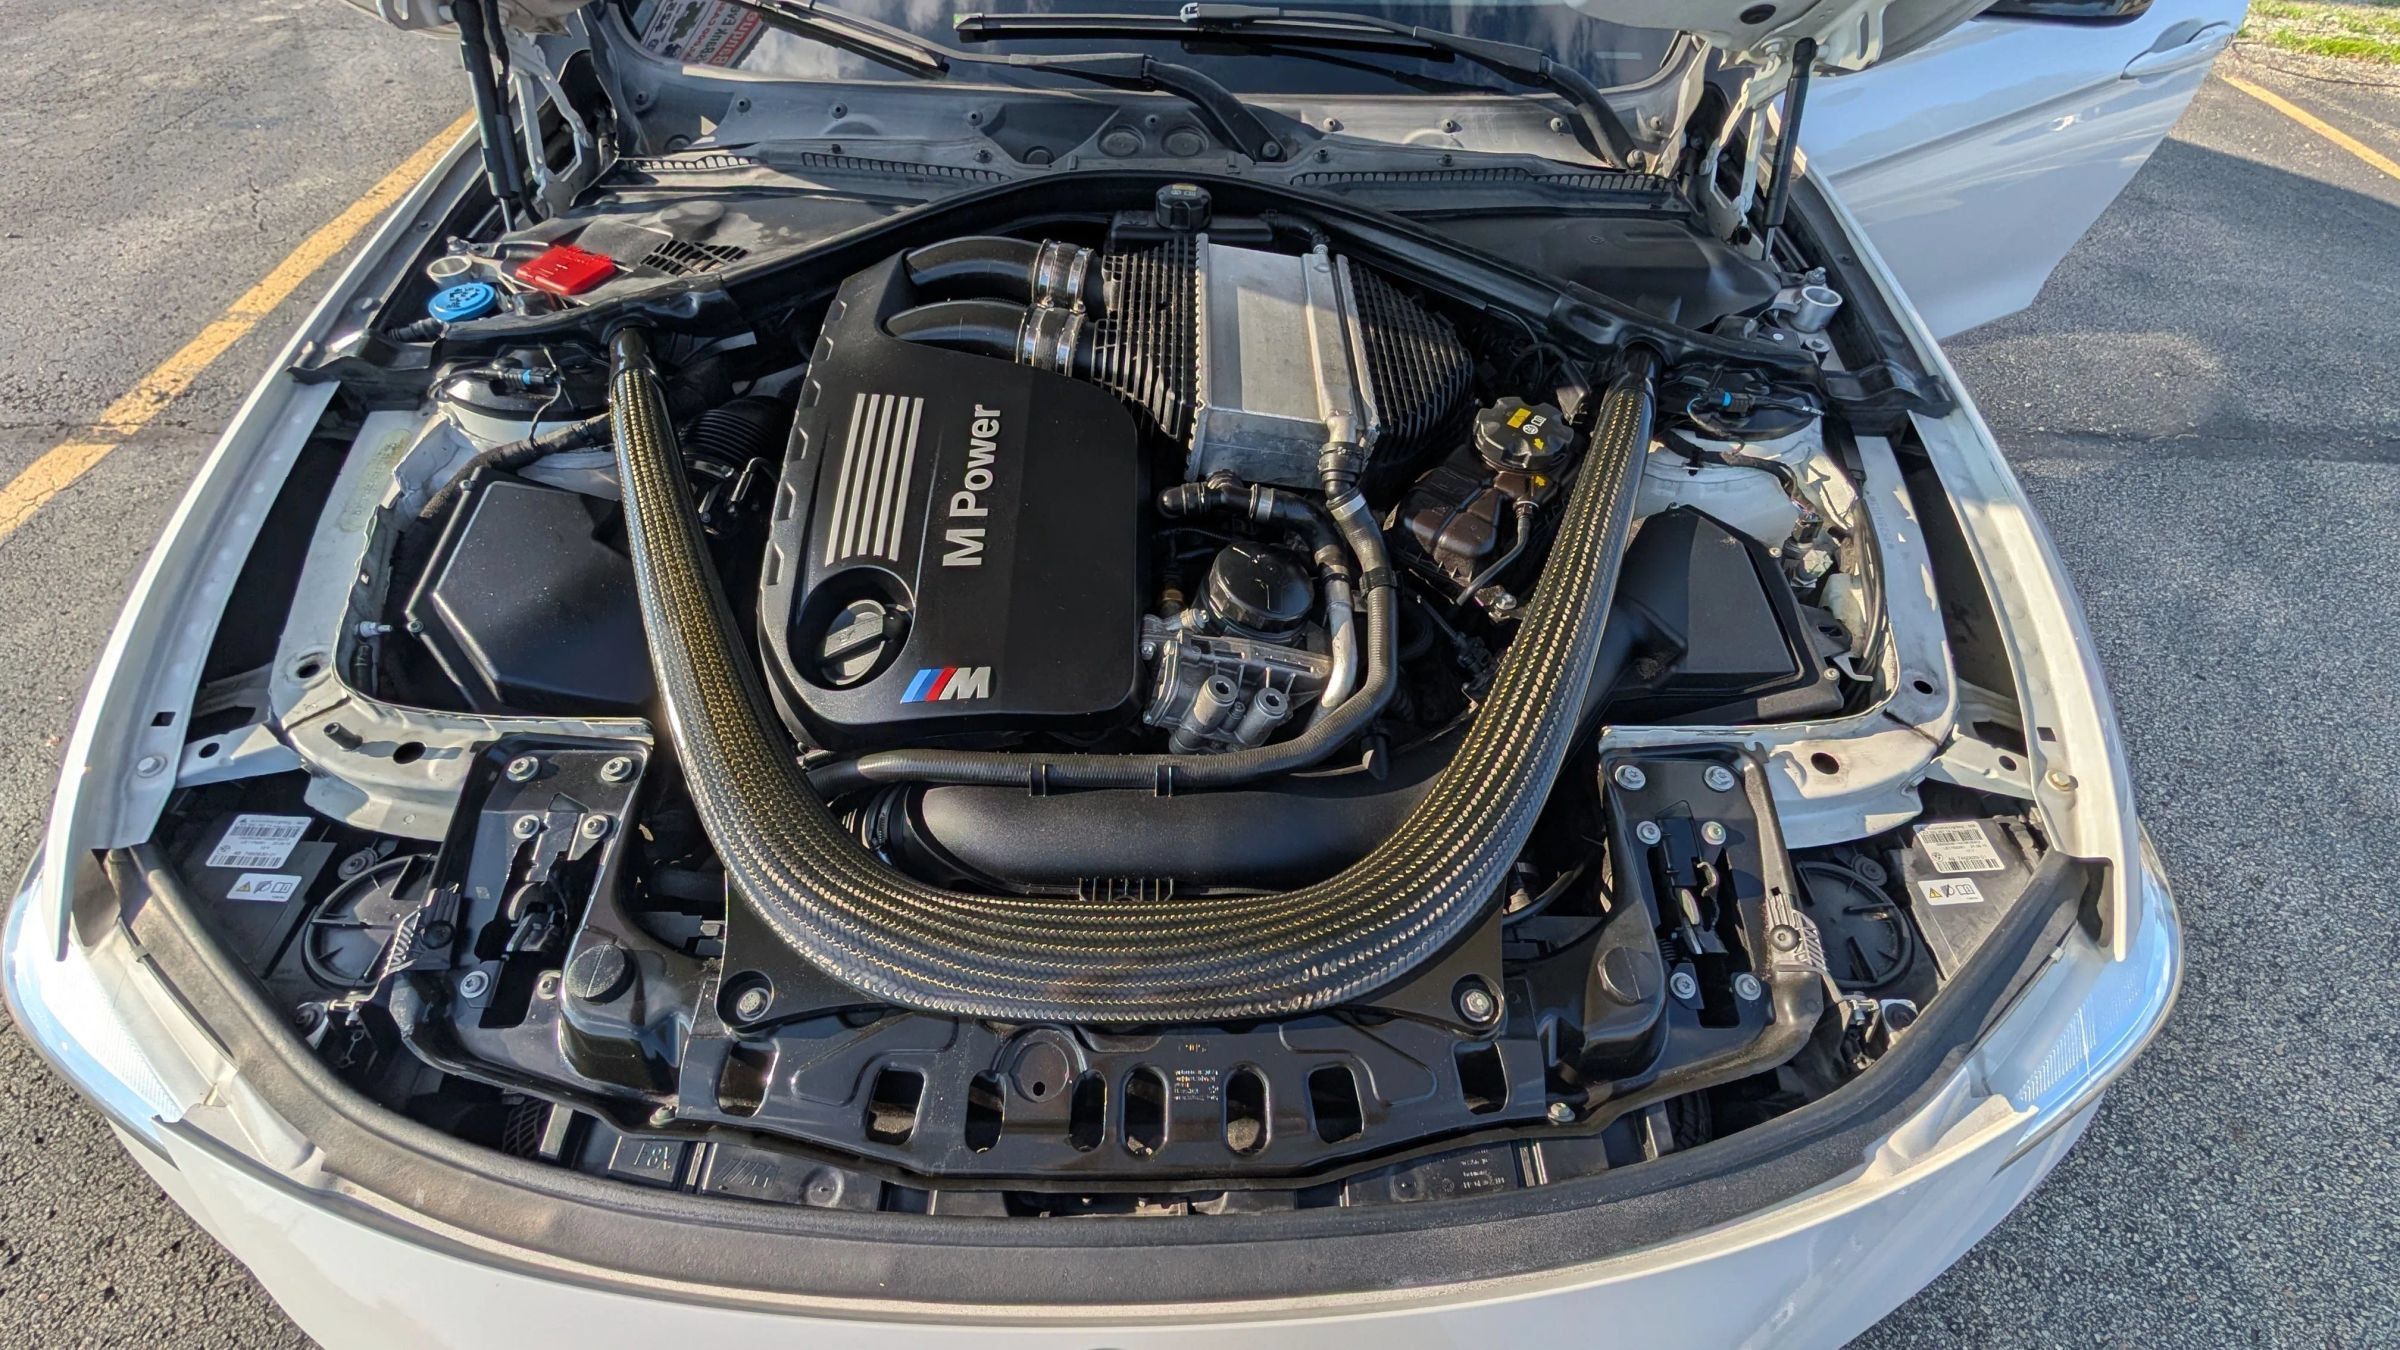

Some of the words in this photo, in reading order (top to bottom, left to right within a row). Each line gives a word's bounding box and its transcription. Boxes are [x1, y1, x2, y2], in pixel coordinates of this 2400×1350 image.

[950, 404, 1001, 517] Power
[942, 528, 986, 566] M
[938, 667, 991, 700] M
